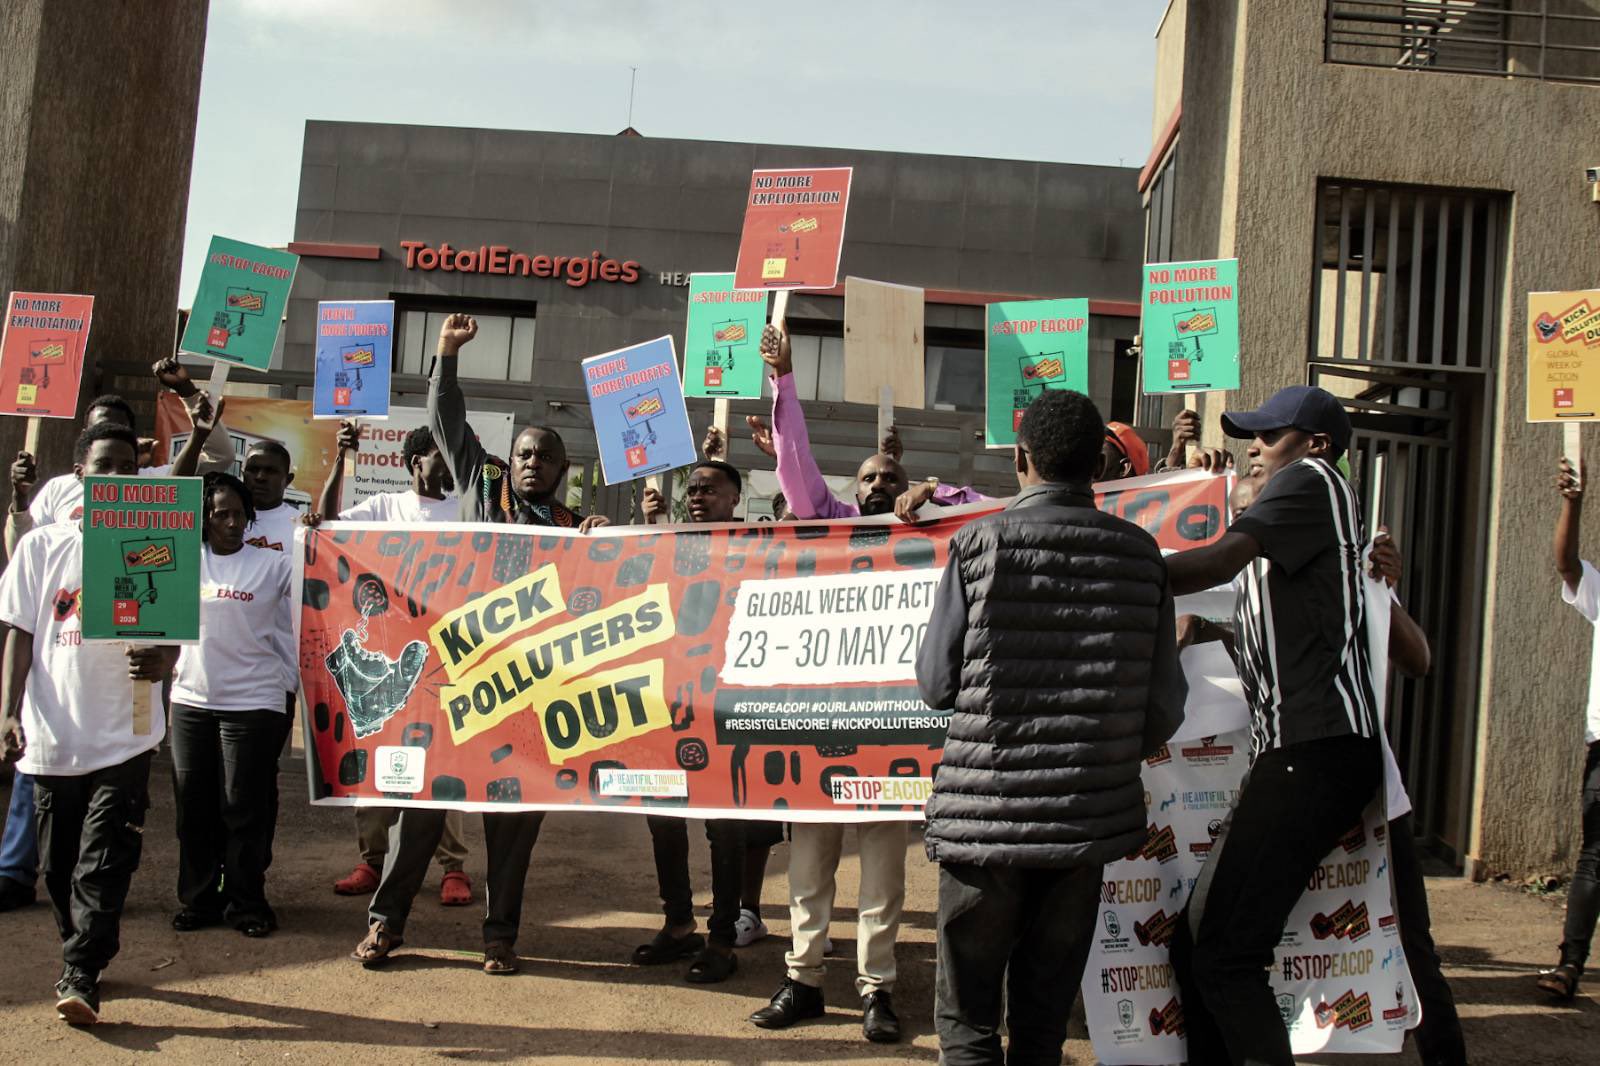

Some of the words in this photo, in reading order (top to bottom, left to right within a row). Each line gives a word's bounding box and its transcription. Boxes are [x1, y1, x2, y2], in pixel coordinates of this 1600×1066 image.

[755, 177, 773, 189] NO
[776, 176, 813, 188] MORE
[752, 191, 841, 206] EXPLIOTATION
[400, 240, 640, 287] TotalEnergies
[1149, 270, 1170, 284] NO
[1174, 267, 1217, 282] MORE
[14, 298, 29, 310] NO
[31, 300, 62, 312] MORE
[1149, 286, 1233, 304] POLLUTION
[1563, 307, 1587, 325] KICK
[993, 320, 1038, 335] #STOP
[1040, 318, 1085, 333] EACOP
[587, 357, 628, 380] PEOPLE
[591, 377, 624, 398] MORE
[624, 361, 672, 387] PROFITS
[355, 475, 370, 483] Our
[91, 483, 119, 502] NO
[123, 484, 178, 504] MORE
[90, 509, 195, 530] POLLUTION
[217, 588, 254, 602] EACOP
[746, 589, 814, 617] GLOBAL
[819, 585, 868, 615] WEEK
[872, 583, 894, 611] OF
[439, 577, 553, 666] KICK
[734, 630, 768, 668] 23
[795, 628, 830, 667] 30
[836, 624, 894, 666] MAY
[449, 600, 664, 732] POLLUTERS
[544, 674, 651, 750] OUT
[734, 701, 810, 714] #STOPEACOP!
[725, 717, 830, 731] #RESISTGLENCORE!
[833, 780, 932, 800] #STOPEACOP
[1283, 949, 1374, 981] #STOPEACOP
[1101, 964, 1173, 993] #STOPEACOP
[1351, 1010, 1368, 1025] OUT
